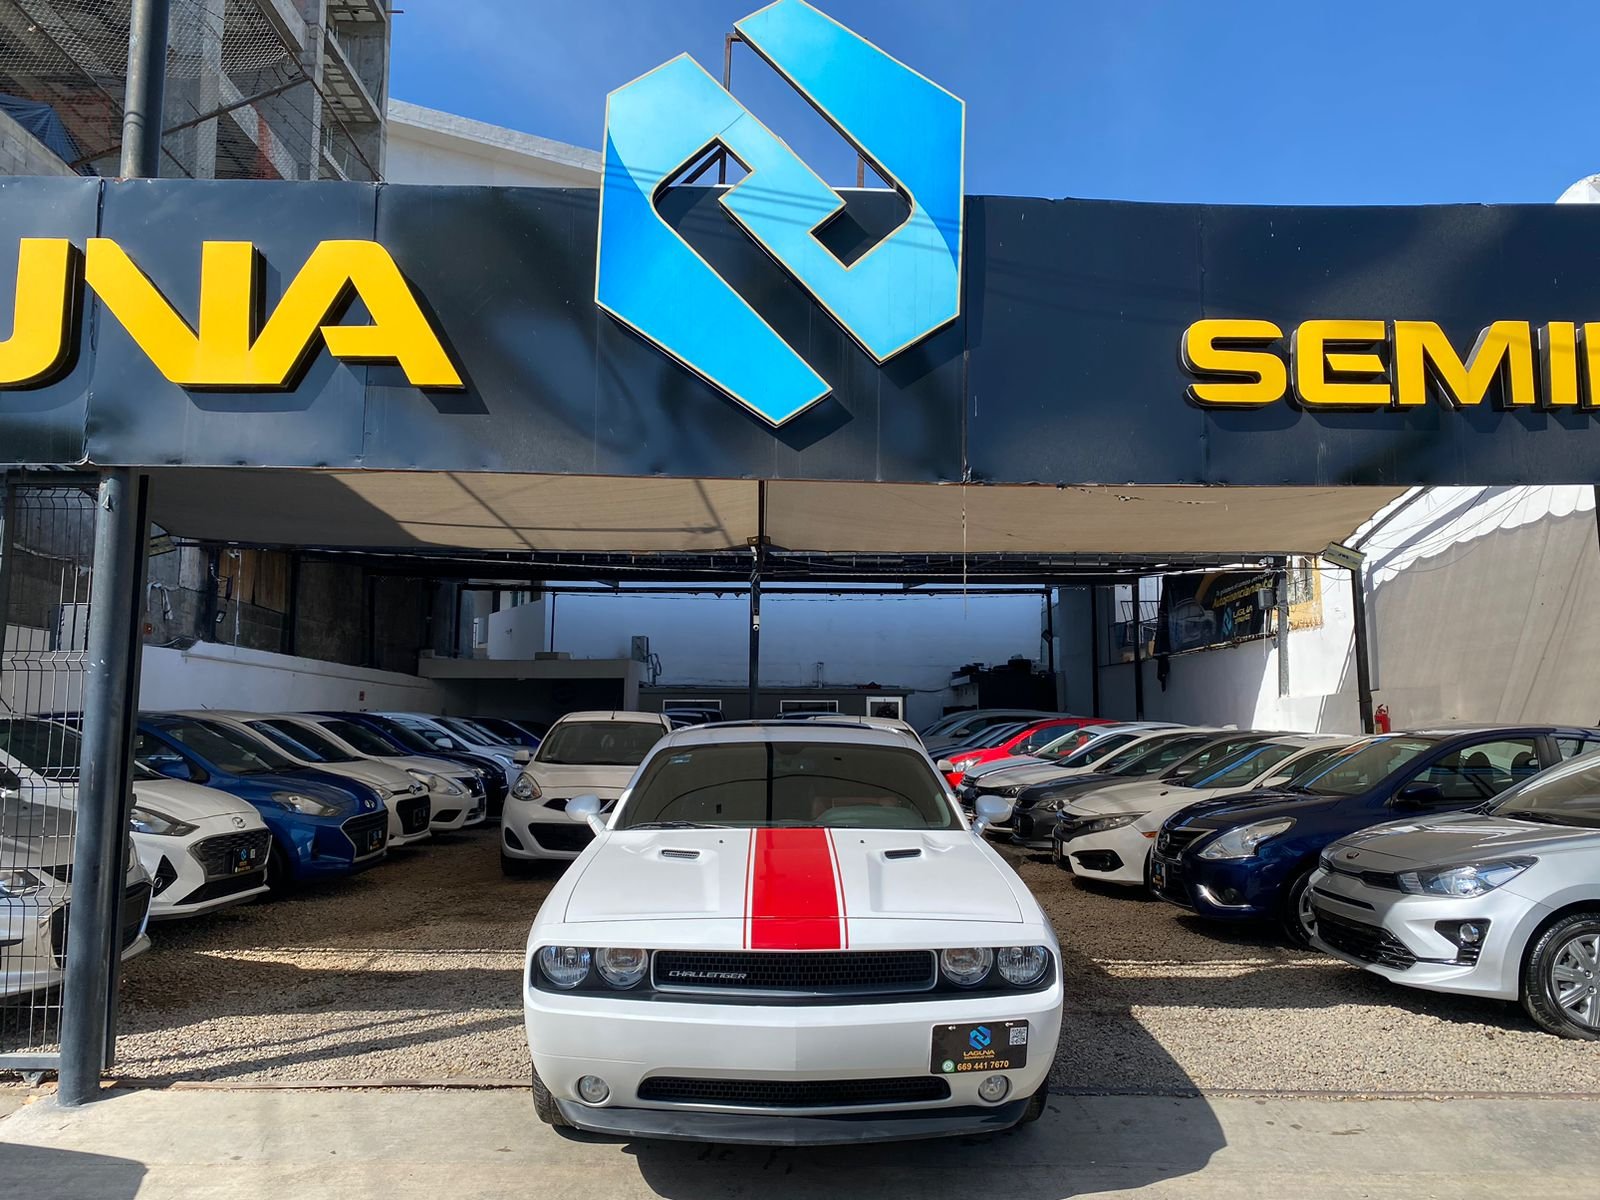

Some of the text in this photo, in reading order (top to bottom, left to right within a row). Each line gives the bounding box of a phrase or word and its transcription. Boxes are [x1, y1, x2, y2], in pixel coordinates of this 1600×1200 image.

[668, 970, 747, 980] CHALLENGER
[957, 1060, 1009, 1071] 669 441 7670
